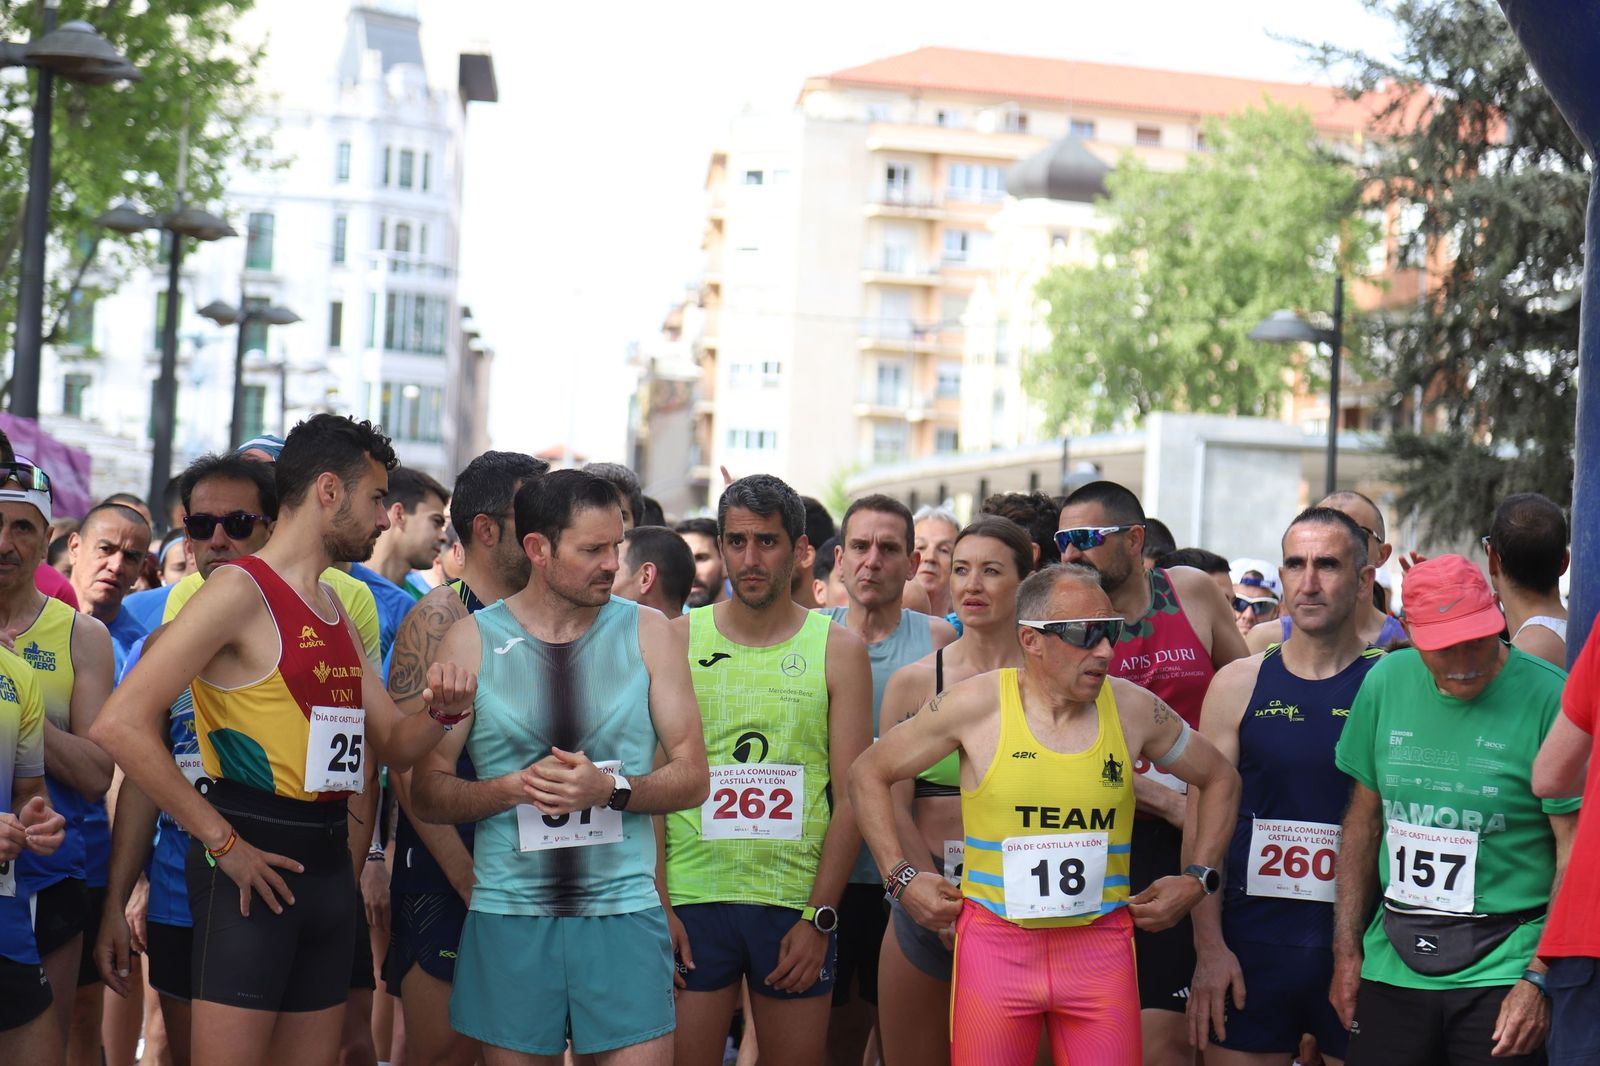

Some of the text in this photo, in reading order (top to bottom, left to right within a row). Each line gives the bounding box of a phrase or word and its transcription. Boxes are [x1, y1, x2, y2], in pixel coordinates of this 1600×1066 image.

[1120, 648, 1196, 671] APIS DURI
[316, 713, 329, 721] DÍA
[330, 715, 338, 723] DE
[1389, 736, 1403, 745] EN
[327, 733, 363, 774] 25
[1012, 751, 1038, 759] 42K
[180, 759, 200, 768] DÍA DE
[724, 769, 735, 777] DE
[736, 768, 746, 776] LA
[747, 768, 798, 777] COMUNIDAD
[764, 777, 786, 785] LEÓN
[712, 787, 794, 820] 262
[1015, 805, 1117, 830] TEAM
[1258, 823, 1271, 831] DÍA
[1007, 842, 1022, 852] DÍA
[1037, 841, 1075, 850] CASTILLA
[1076, 840, 1081, 848] Y
[1082, 838, 1102, 848] LEÓN
[1268, 834, 1302, 842] CASTILLA
[1311, 835, 1334, 845] LEÓN
[1409, 831, 1441, 842] CASTILLA
[1450, 837, 1473, 845] LEÓN
[1258, 844, 1337, 882] 260
[1396, 845, 1467, 891] 157
[1030, 858, 1086, 897] 18
